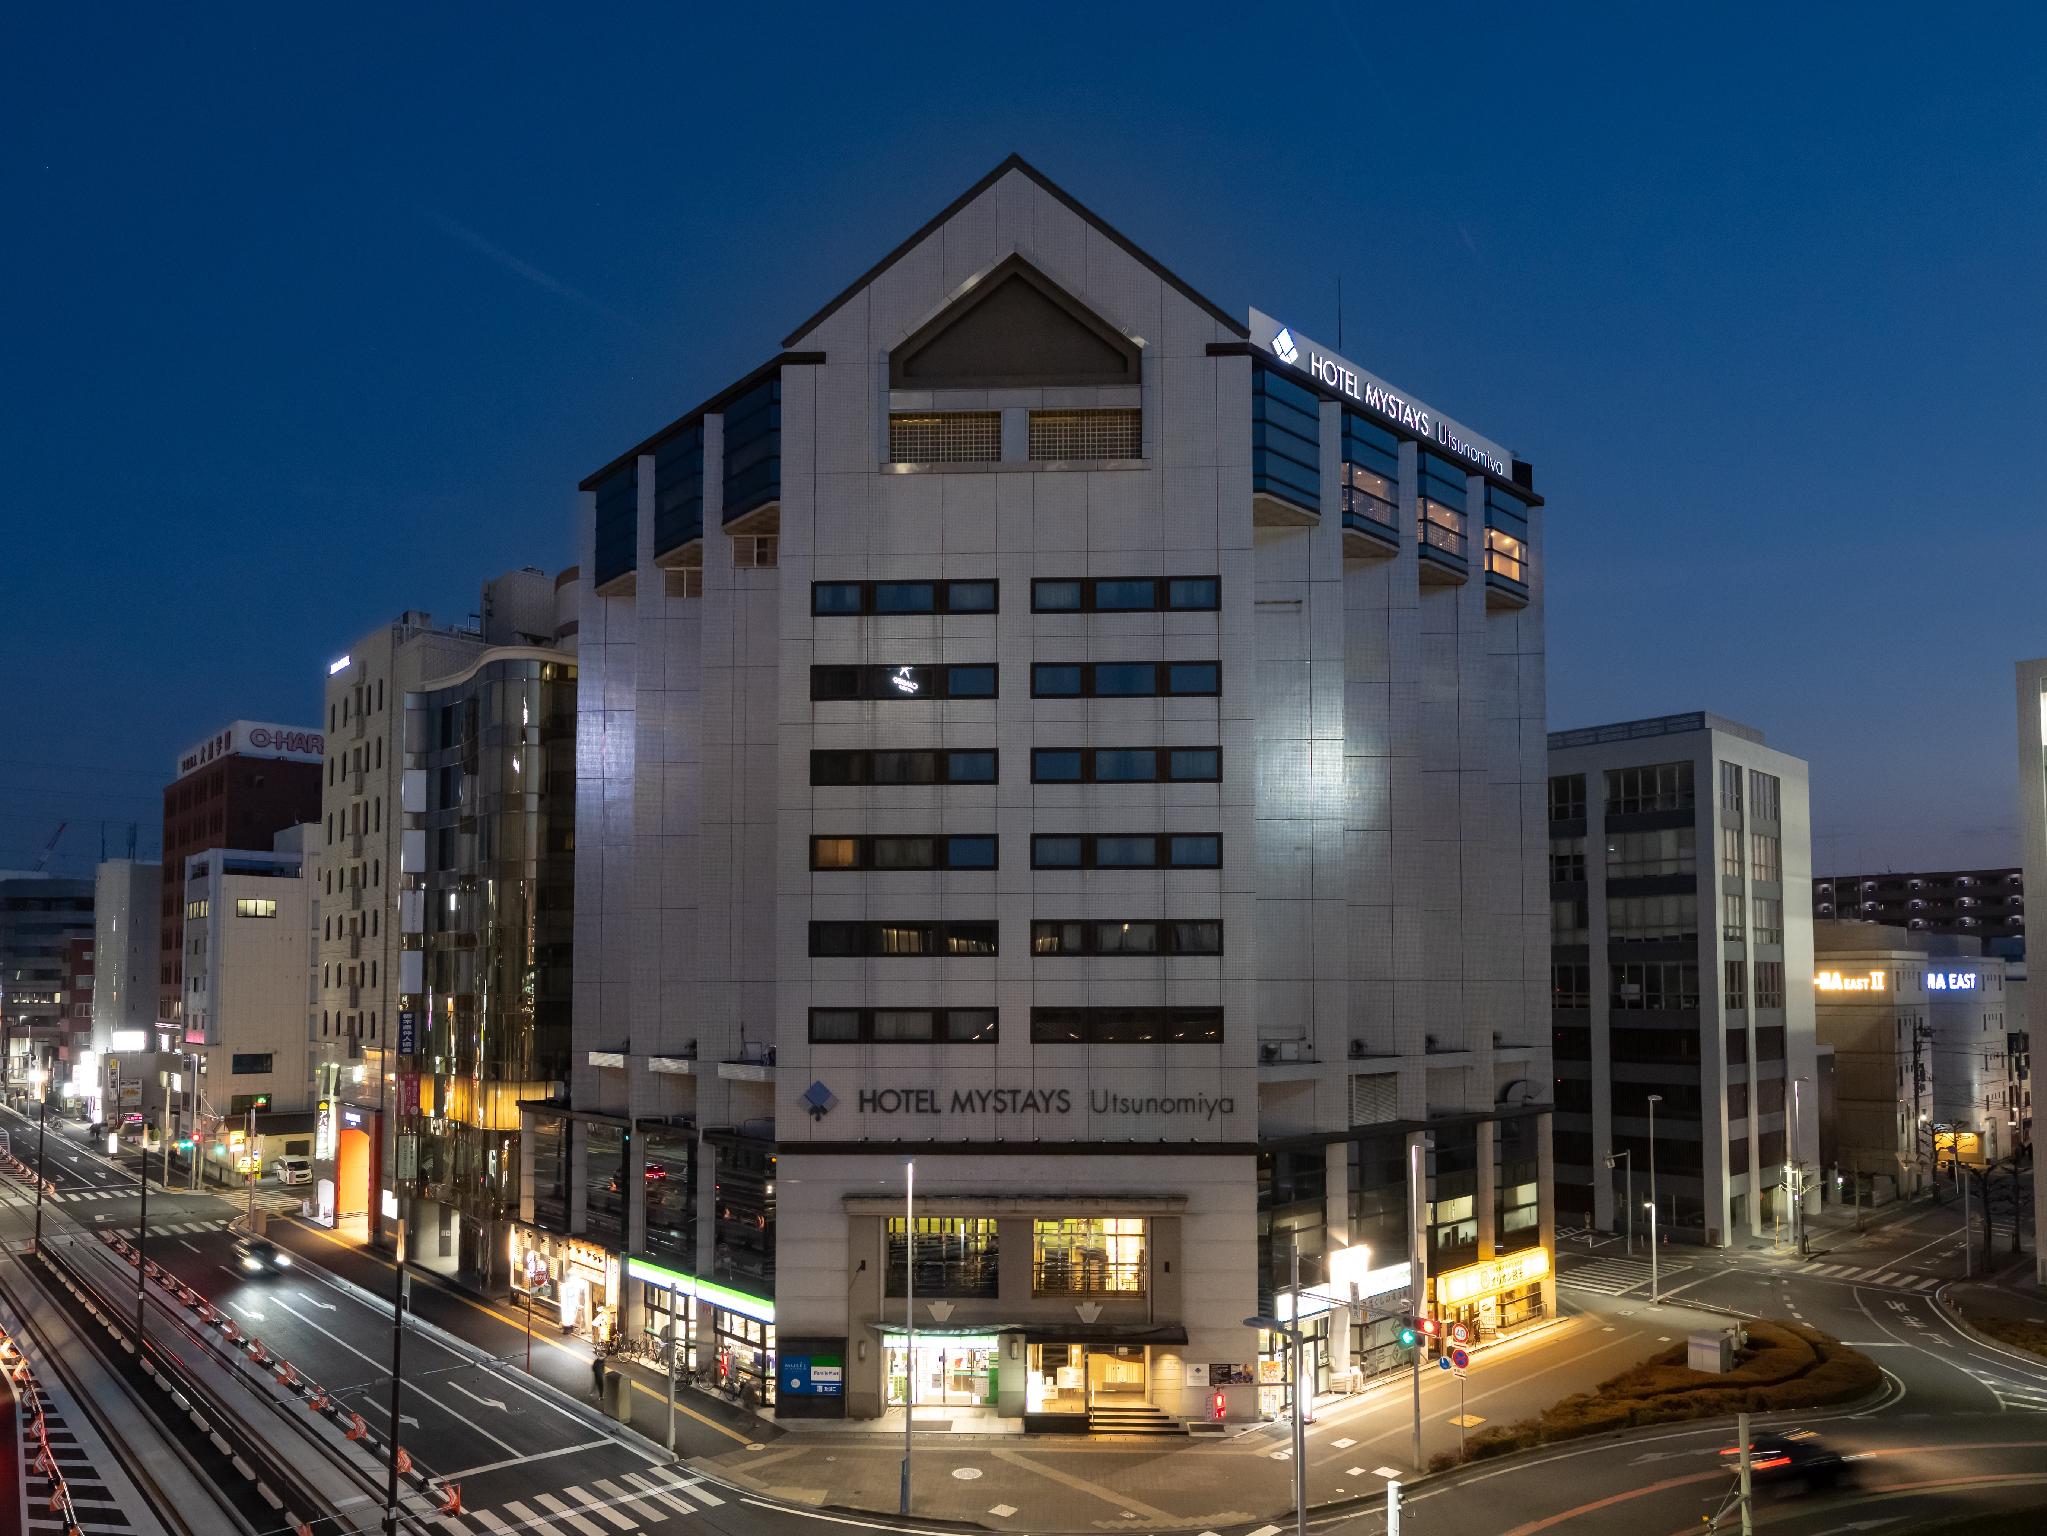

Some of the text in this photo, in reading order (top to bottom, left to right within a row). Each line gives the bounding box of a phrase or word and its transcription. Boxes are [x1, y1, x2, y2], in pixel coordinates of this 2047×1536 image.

[1310, 351, 1503, 476] HOTEL MYSTAYS Utsunomiya
[1844, 977, 1870, 990] EAST
[1949, 973, 1977, 990] EAST
[859, 1088, 1235, 1122] HOTEL MYSTAYS Utsunomiya
[1456, 1328, 1466, 1339] 40
